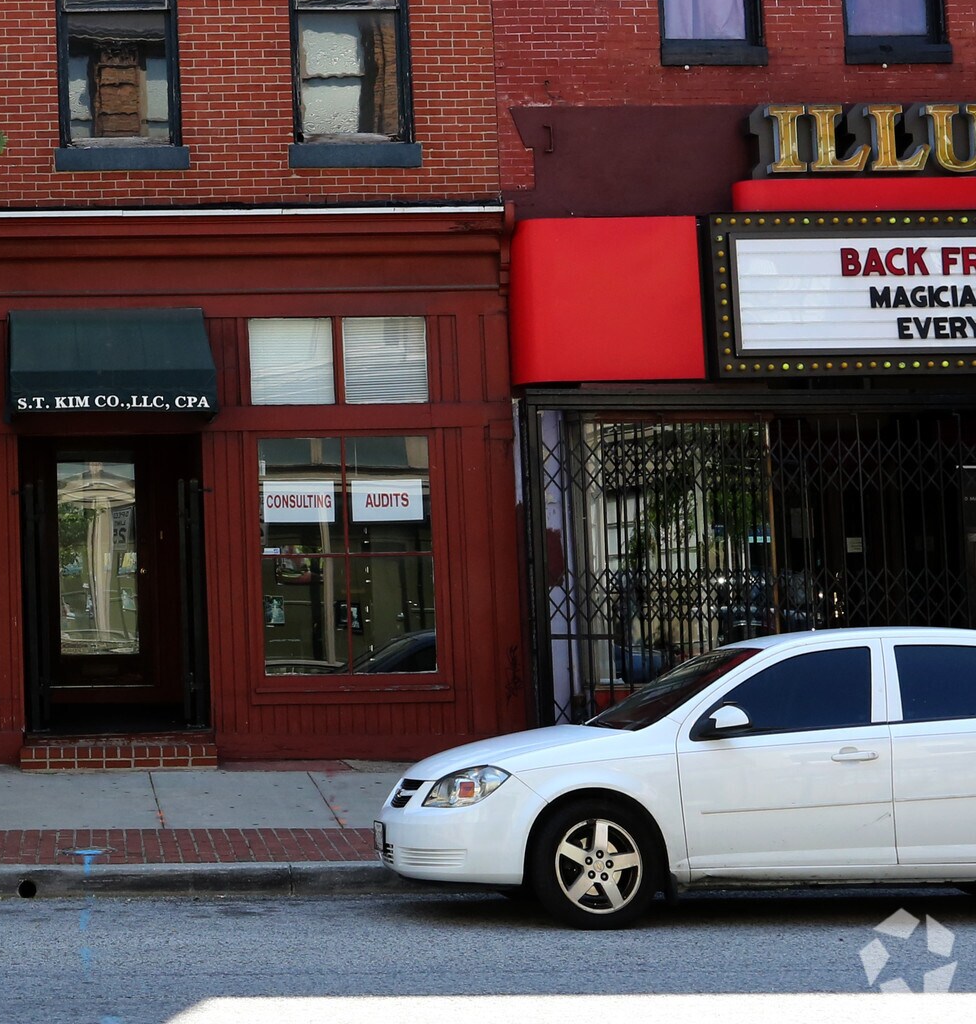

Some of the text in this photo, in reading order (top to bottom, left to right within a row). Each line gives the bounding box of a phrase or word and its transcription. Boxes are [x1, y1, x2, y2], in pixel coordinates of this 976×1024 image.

[765, 104, 976, 173] ILLU
[840, 247, 929, 276] BACK
[17, 397, 50, 410] S.T.
[54, 395, 90, 409] KIM
[174, 395, 210, 408] CPA
[266, 494, 332, 508] CONSULTING
[365, 493, 409, 508] AUDITS
